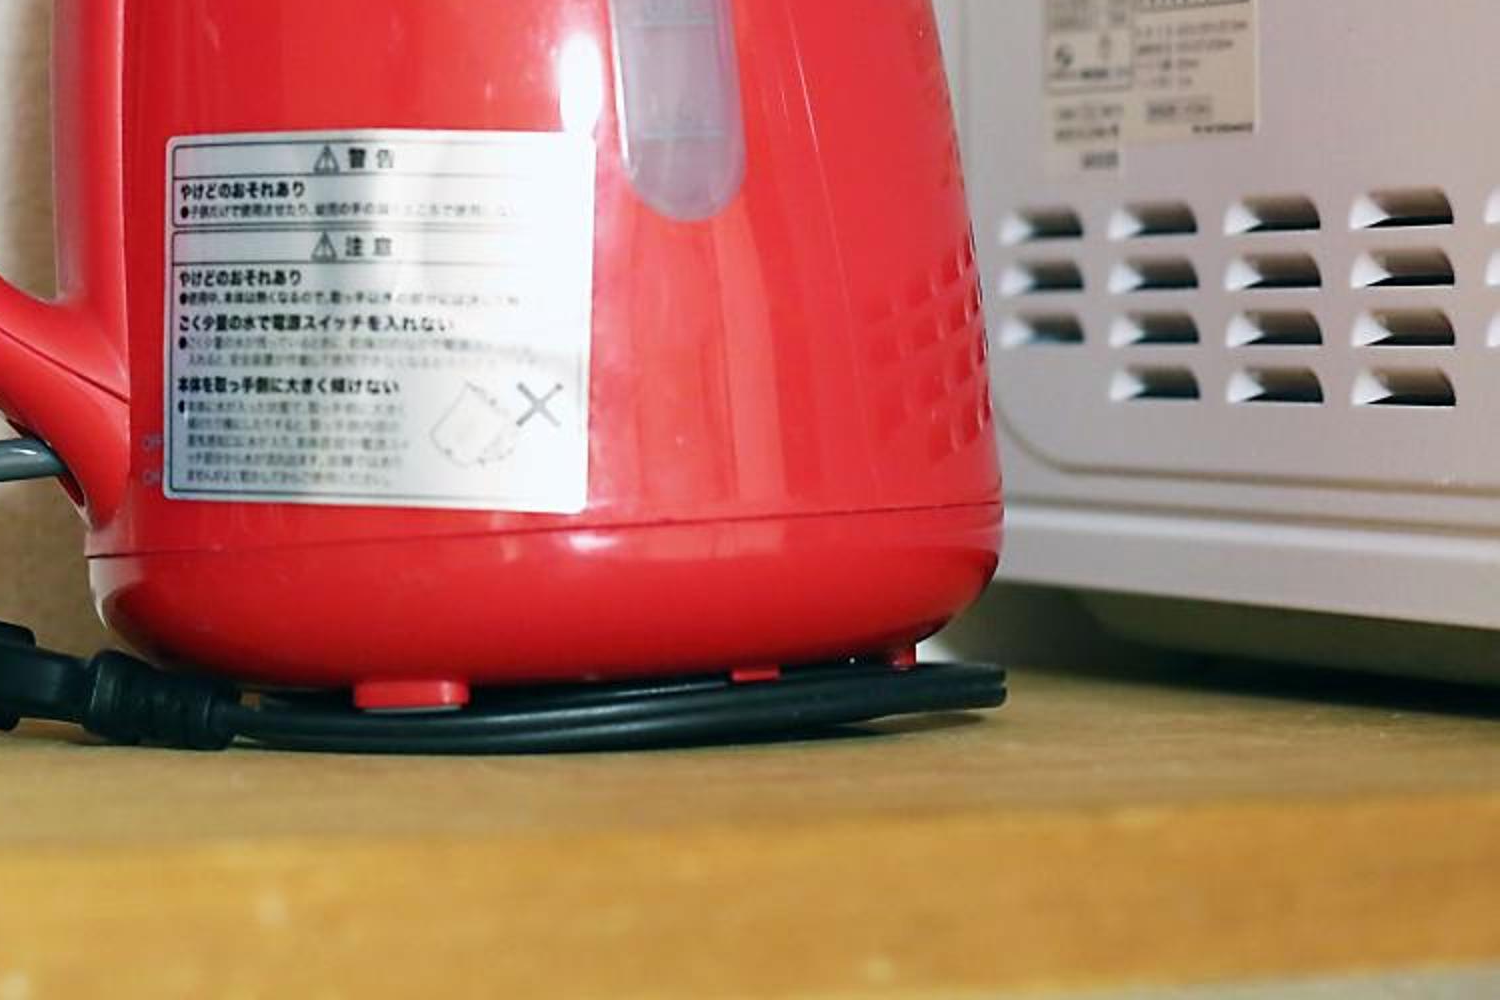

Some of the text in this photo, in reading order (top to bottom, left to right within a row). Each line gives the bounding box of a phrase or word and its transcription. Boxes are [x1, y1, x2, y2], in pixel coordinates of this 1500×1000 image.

[180, 181, 305, 200] やけどのおそれあり
[179, 269, 301, 287] やけどのおそれあり
